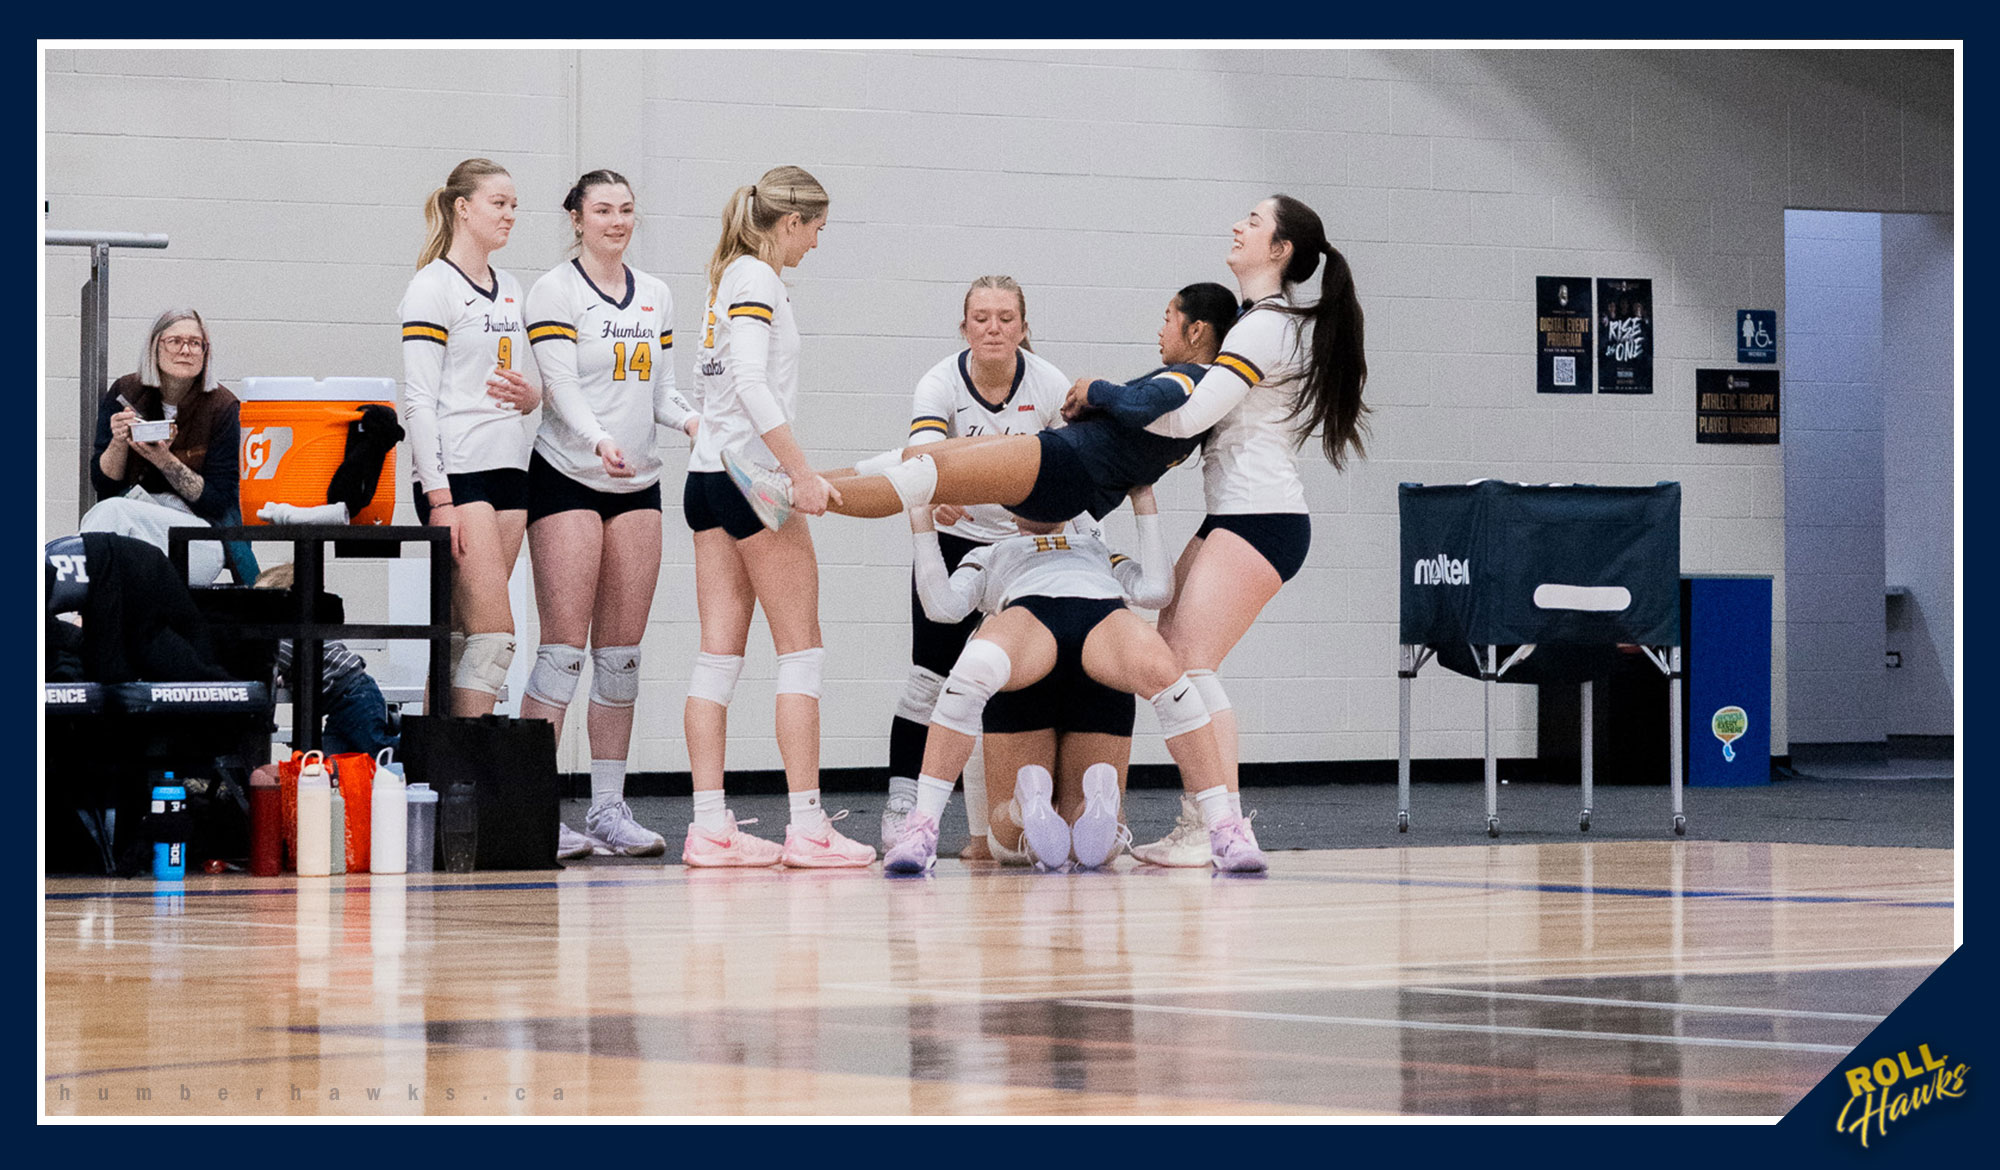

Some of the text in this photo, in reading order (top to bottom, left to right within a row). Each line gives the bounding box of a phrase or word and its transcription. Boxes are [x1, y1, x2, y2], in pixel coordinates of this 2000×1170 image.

[484, 314, 520, 332] Humber
[601, 320, 654, 338] Humber
[1540, 316, 1588, 333] DIGITAL EVENT
[1609, 317, 1641, 341] RISE
[1547, 332, 1581, 347] PROGRAM
[498, 336, 512, 369] 9
[1615, 337, 1644, 361] ONE
[613, 341, 652, 381] 14
[1701, 393, 1774, 410] ATHLETIC THERAPY
[1699, 416, 1777, 434] PLAYER WASHROOM
[50, 555, 90, 583] PI
[1414, 554, 1470, 586] molten
[151, 687, 249, 702] PROVIDENCE
